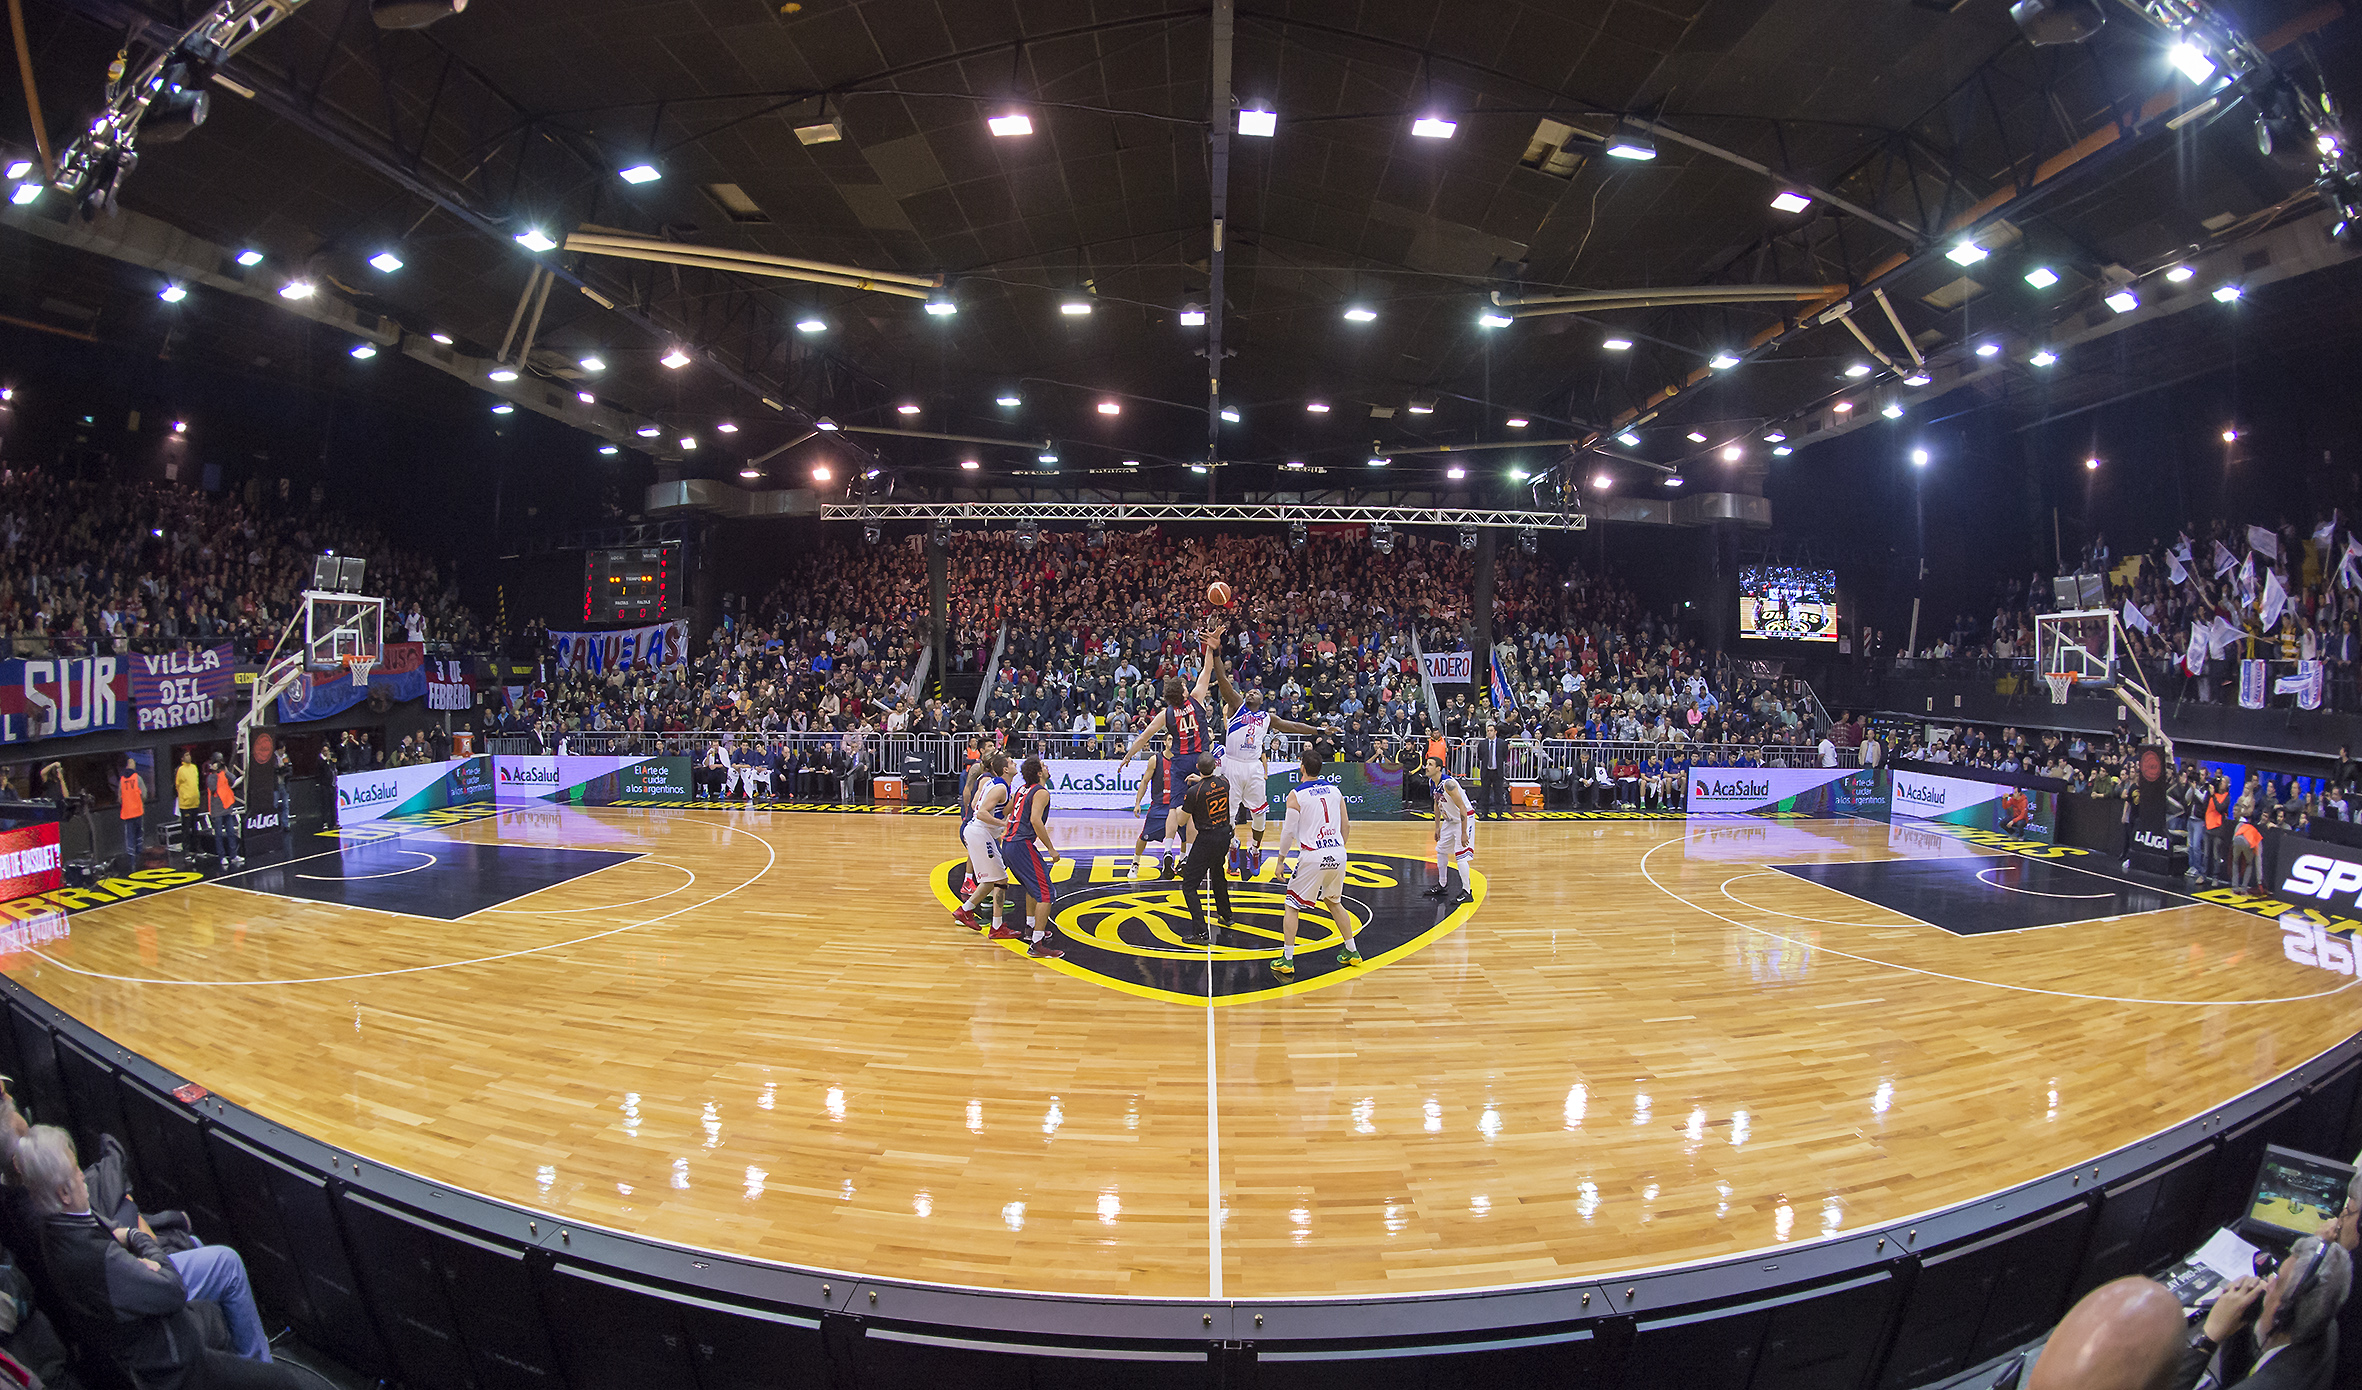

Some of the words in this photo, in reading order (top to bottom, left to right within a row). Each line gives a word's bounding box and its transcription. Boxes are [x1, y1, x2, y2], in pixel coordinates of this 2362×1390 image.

[640, 608, 646, 618] 0
[24, 657, 117, 735] SUR
[159, 676, 208, 705] DEL
[428, 682, 471, 710] FEBRERO
[138, 698, 222, 731] PARQU
[1179, 714, 1199, 734] 44
[513, 766, 560, 783] AcaSalud
[642, 766, 657, 775] Arte
[657, 766, 669, 775] de
[1289, 772, 1299, 783] El
[1326, 772, 1342, 783] de
[632, 784, 642, 793] los
[642, 776, 667, 784] cuidar
[884, 783, 892, 792] G
[1712, 779, 1770, 797] AcaSalud
[353, 780, 398, 804] AcaSalud
[1273, 794, 1280, 803] a
[1906, 783, 1946, 805] AcaSalud
[1209, 797, 1228, 815] 22
[1319, 797, 1330, 824] 1
[0, 867, 204, 927] BRAS
